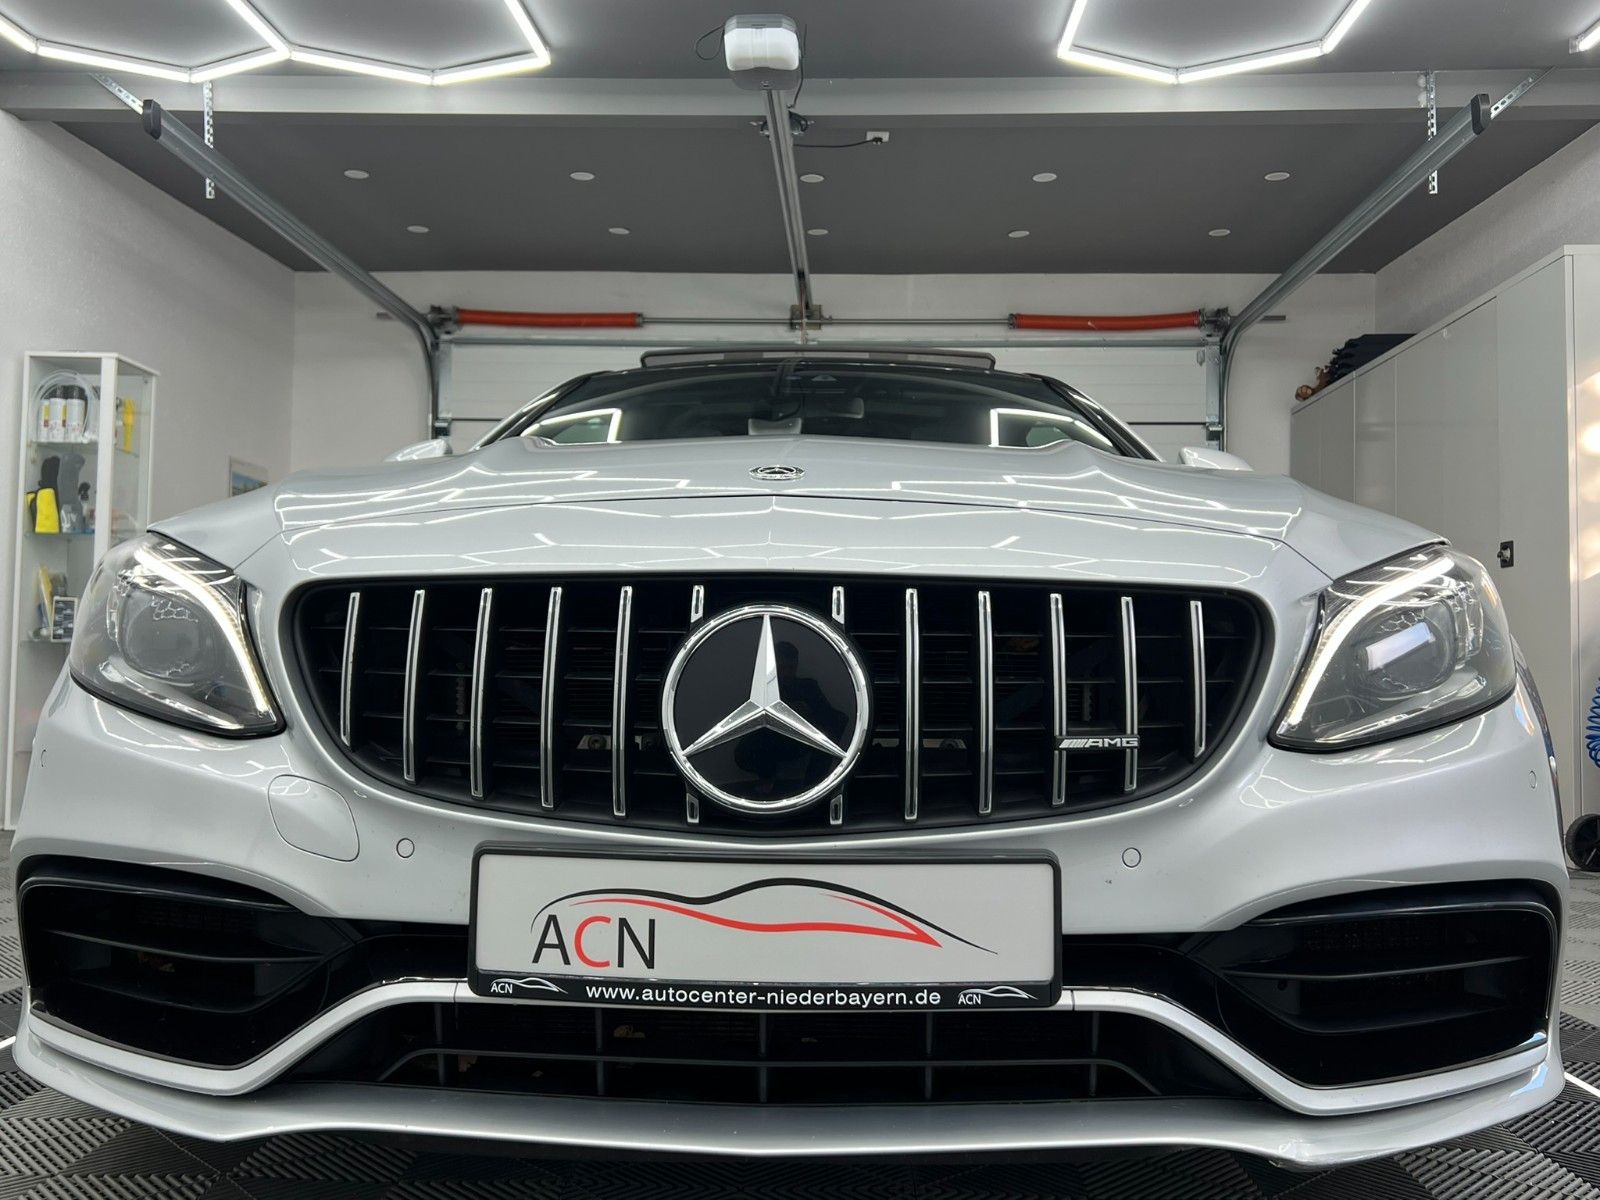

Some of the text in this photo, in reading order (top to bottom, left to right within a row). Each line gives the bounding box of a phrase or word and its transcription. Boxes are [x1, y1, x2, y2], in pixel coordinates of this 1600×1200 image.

[1084, 738, 1139, 748] AMG
[532, 914, 656, 969] ACN
[491, 983, 513, 994] ACN
[586, 986, 941, 1007] www.autocenter-niederbayern.de
[958, 993, 982, 1005] ACN
